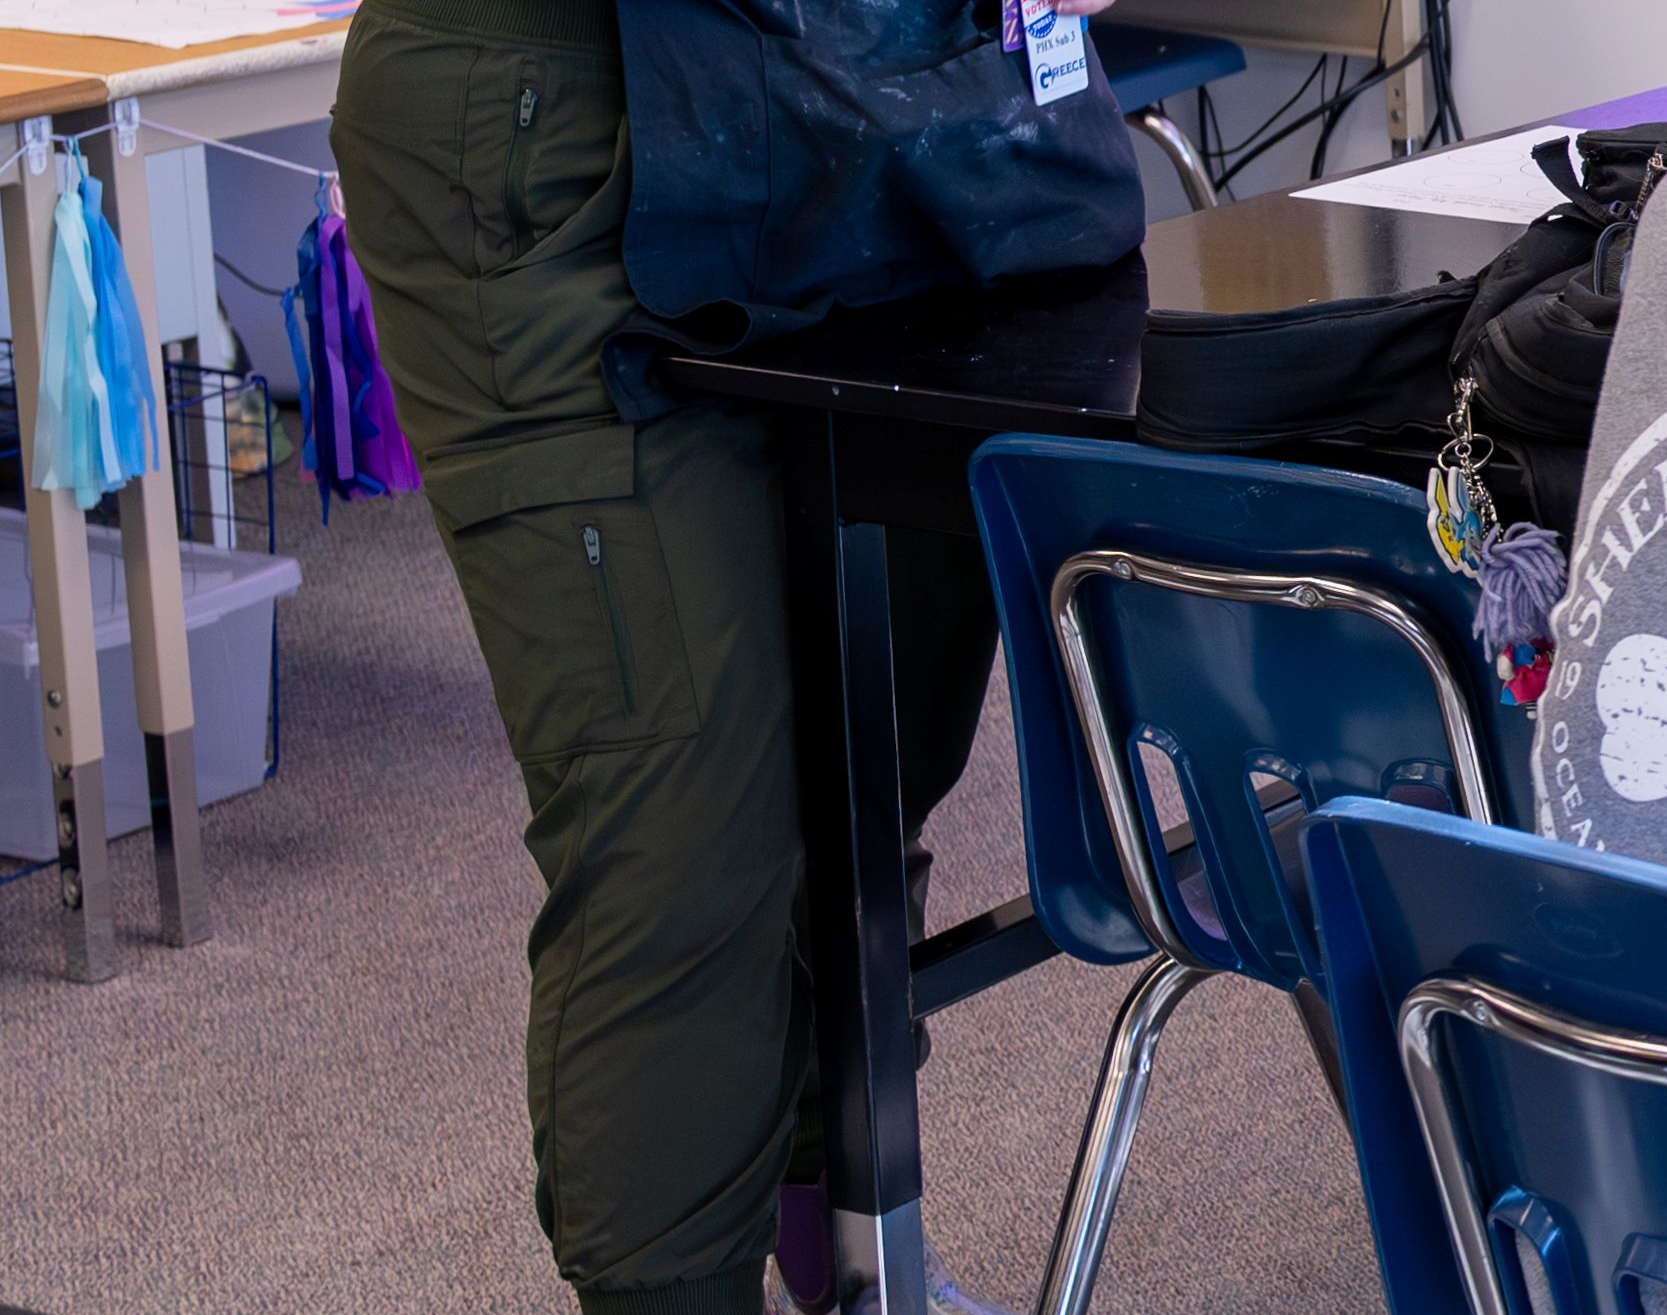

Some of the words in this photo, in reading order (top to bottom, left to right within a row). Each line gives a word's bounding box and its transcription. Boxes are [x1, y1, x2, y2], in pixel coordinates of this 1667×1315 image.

[1036, 40, 1054, 55] PHX
[1056, 34, 1070, 46] Sub
[1071, 30, 1077, 43] 3
[1035, 56, 1087, 90] GREECE
[1555, 660, 1582, 701] 19
[1551, 720, 1605, 851] OCEA
